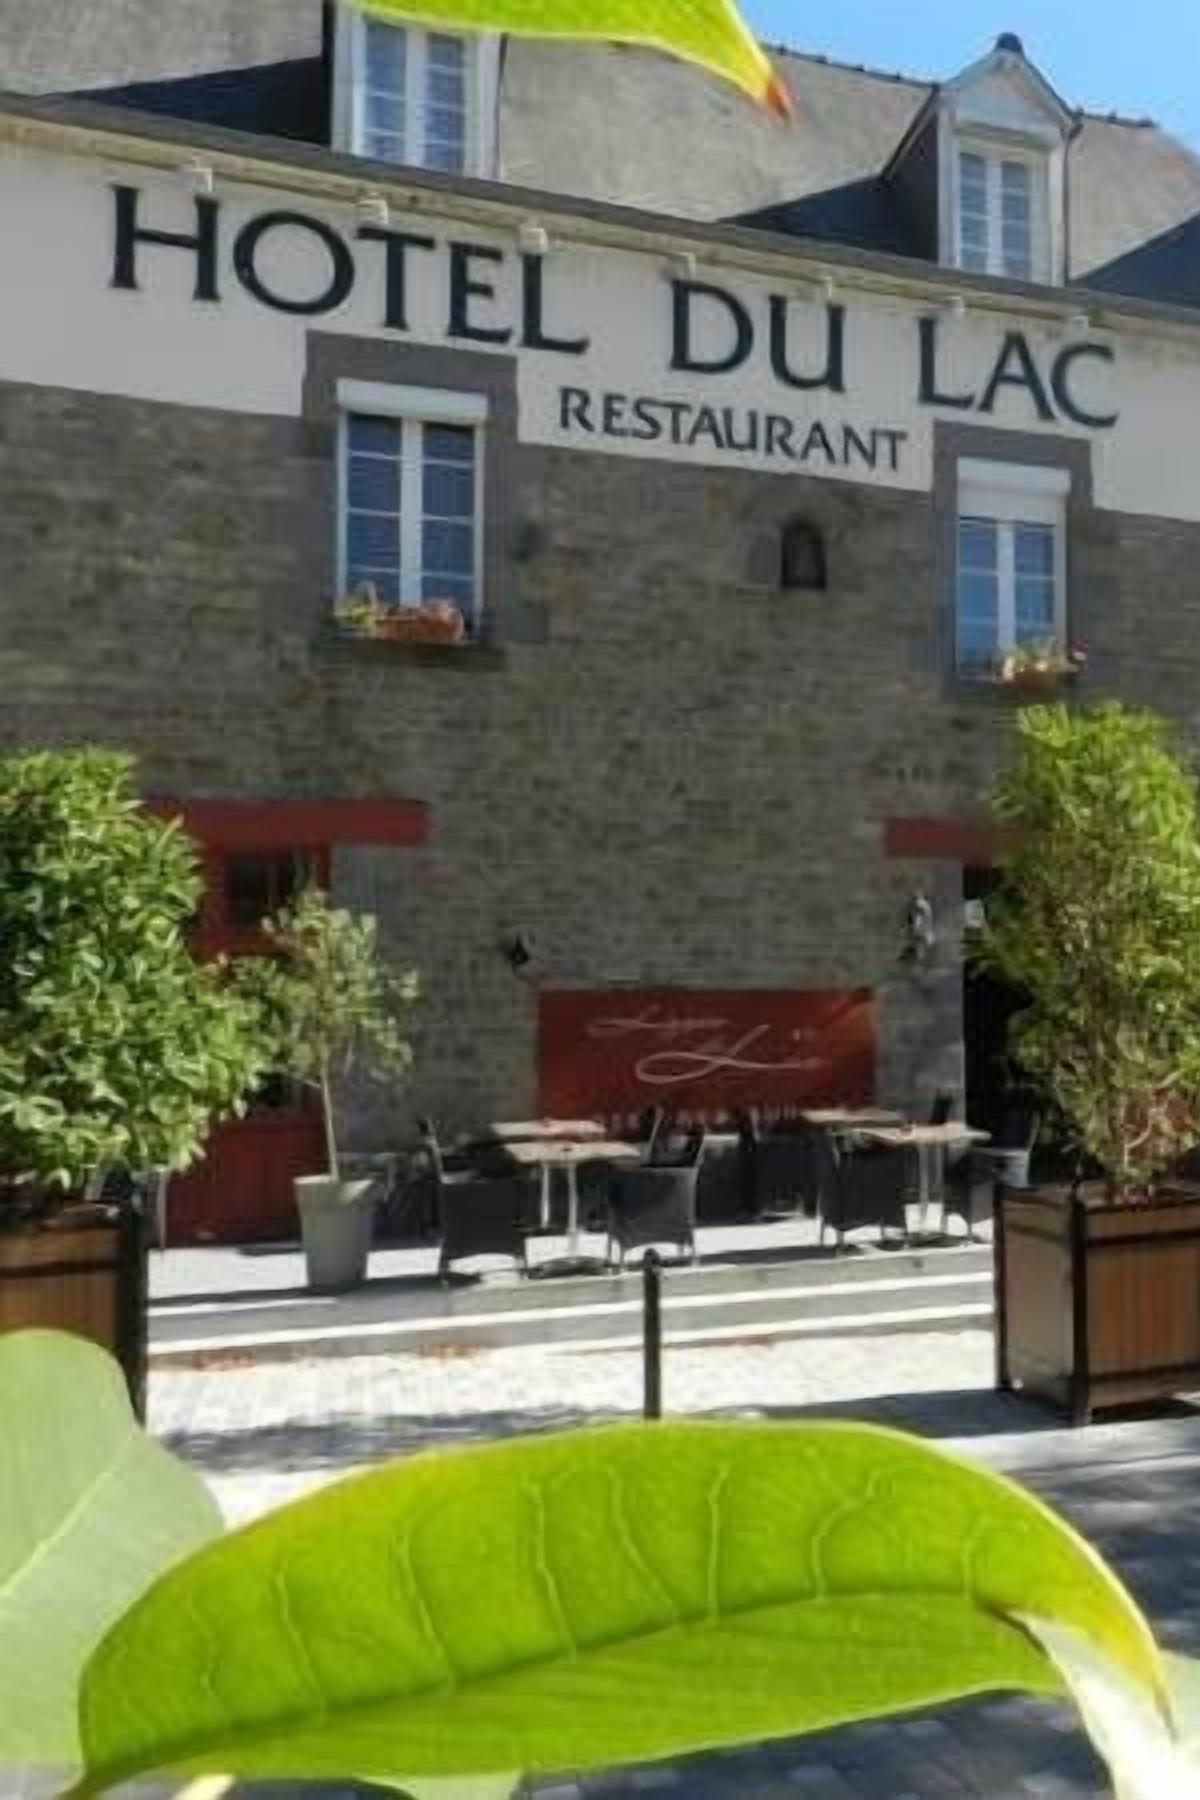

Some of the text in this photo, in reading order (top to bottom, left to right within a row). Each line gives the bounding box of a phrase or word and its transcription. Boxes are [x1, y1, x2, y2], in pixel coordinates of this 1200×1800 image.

[109, 184, 1118, 429] HOTEL DU LAC
[559, 386, 908, 471] RESTAURANT
